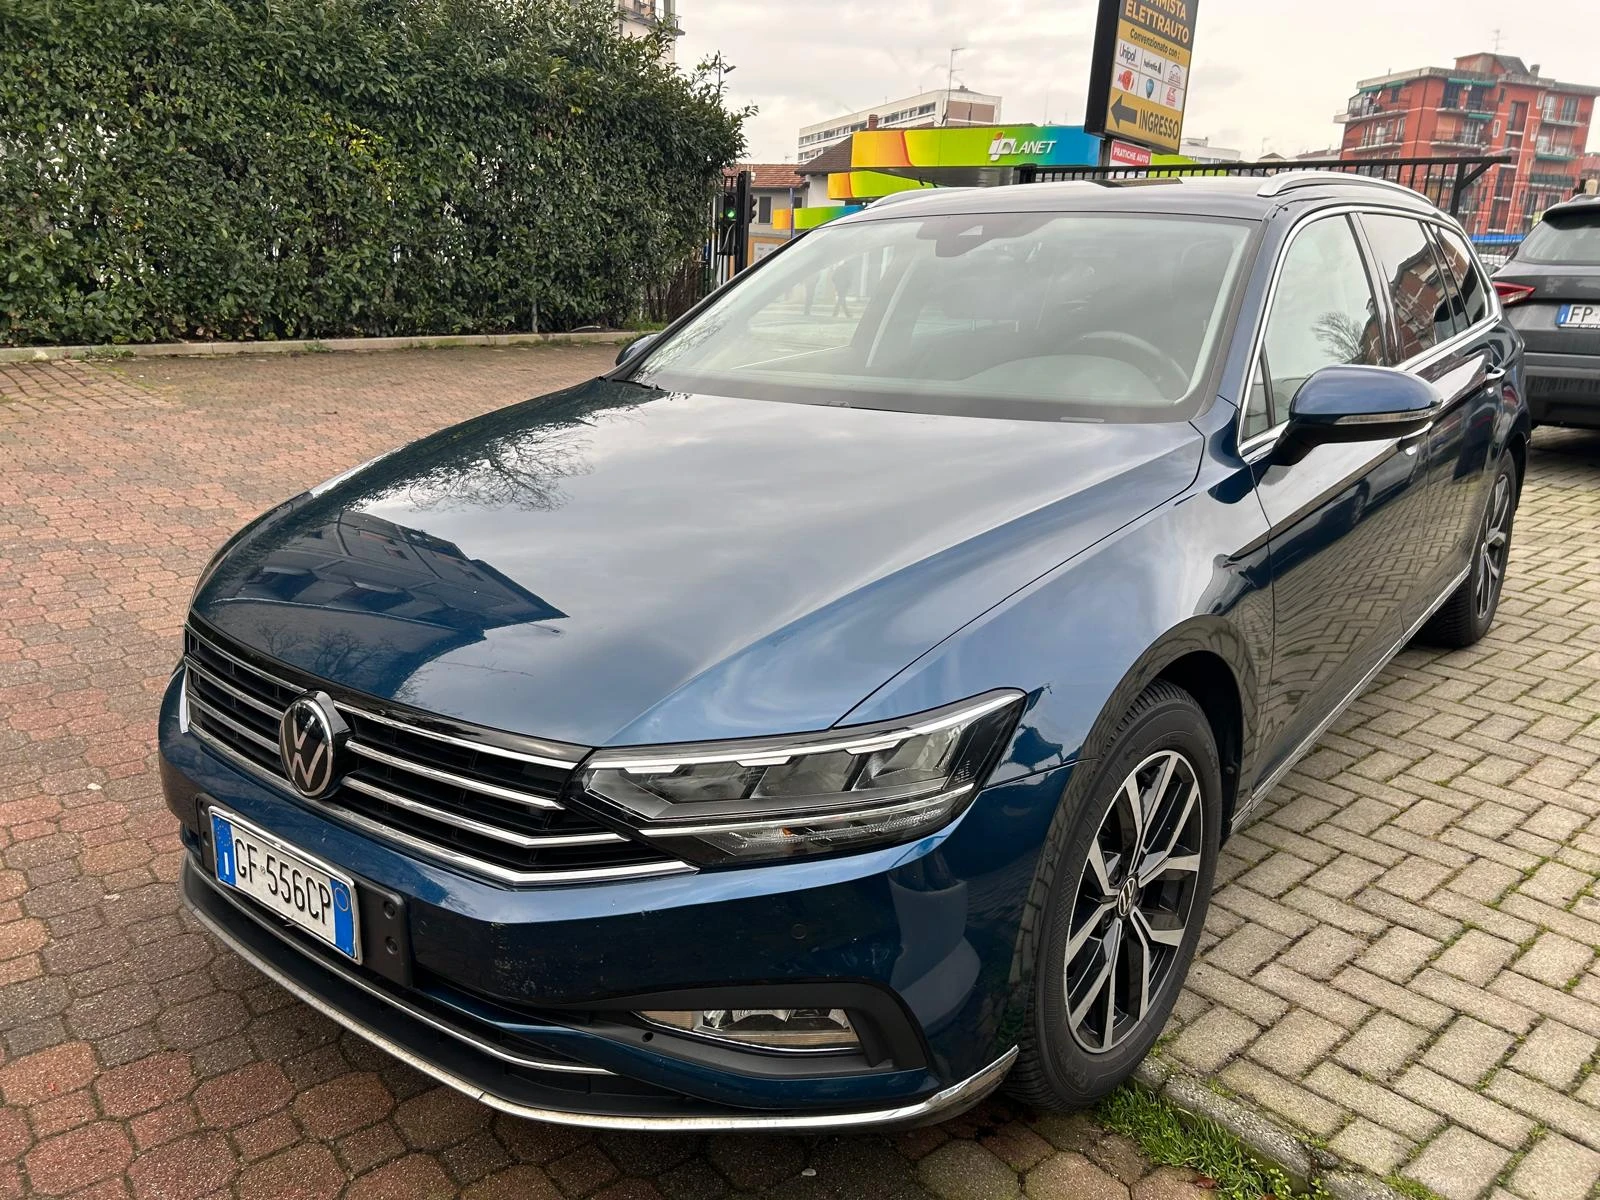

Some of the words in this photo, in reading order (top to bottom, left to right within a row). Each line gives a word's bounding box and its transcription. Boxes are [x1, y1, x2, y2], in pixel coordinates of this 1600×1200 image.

[1125, 0, 1189, 43] ELETTRAUTO
[1130, 28, 1168, 54] Convenzionato
[1138, 108, 1179, 139] INGRESSO
[1113, 147, 1136, 161] PRATICHE
[1136, 152, 1149, 164] AUTO
